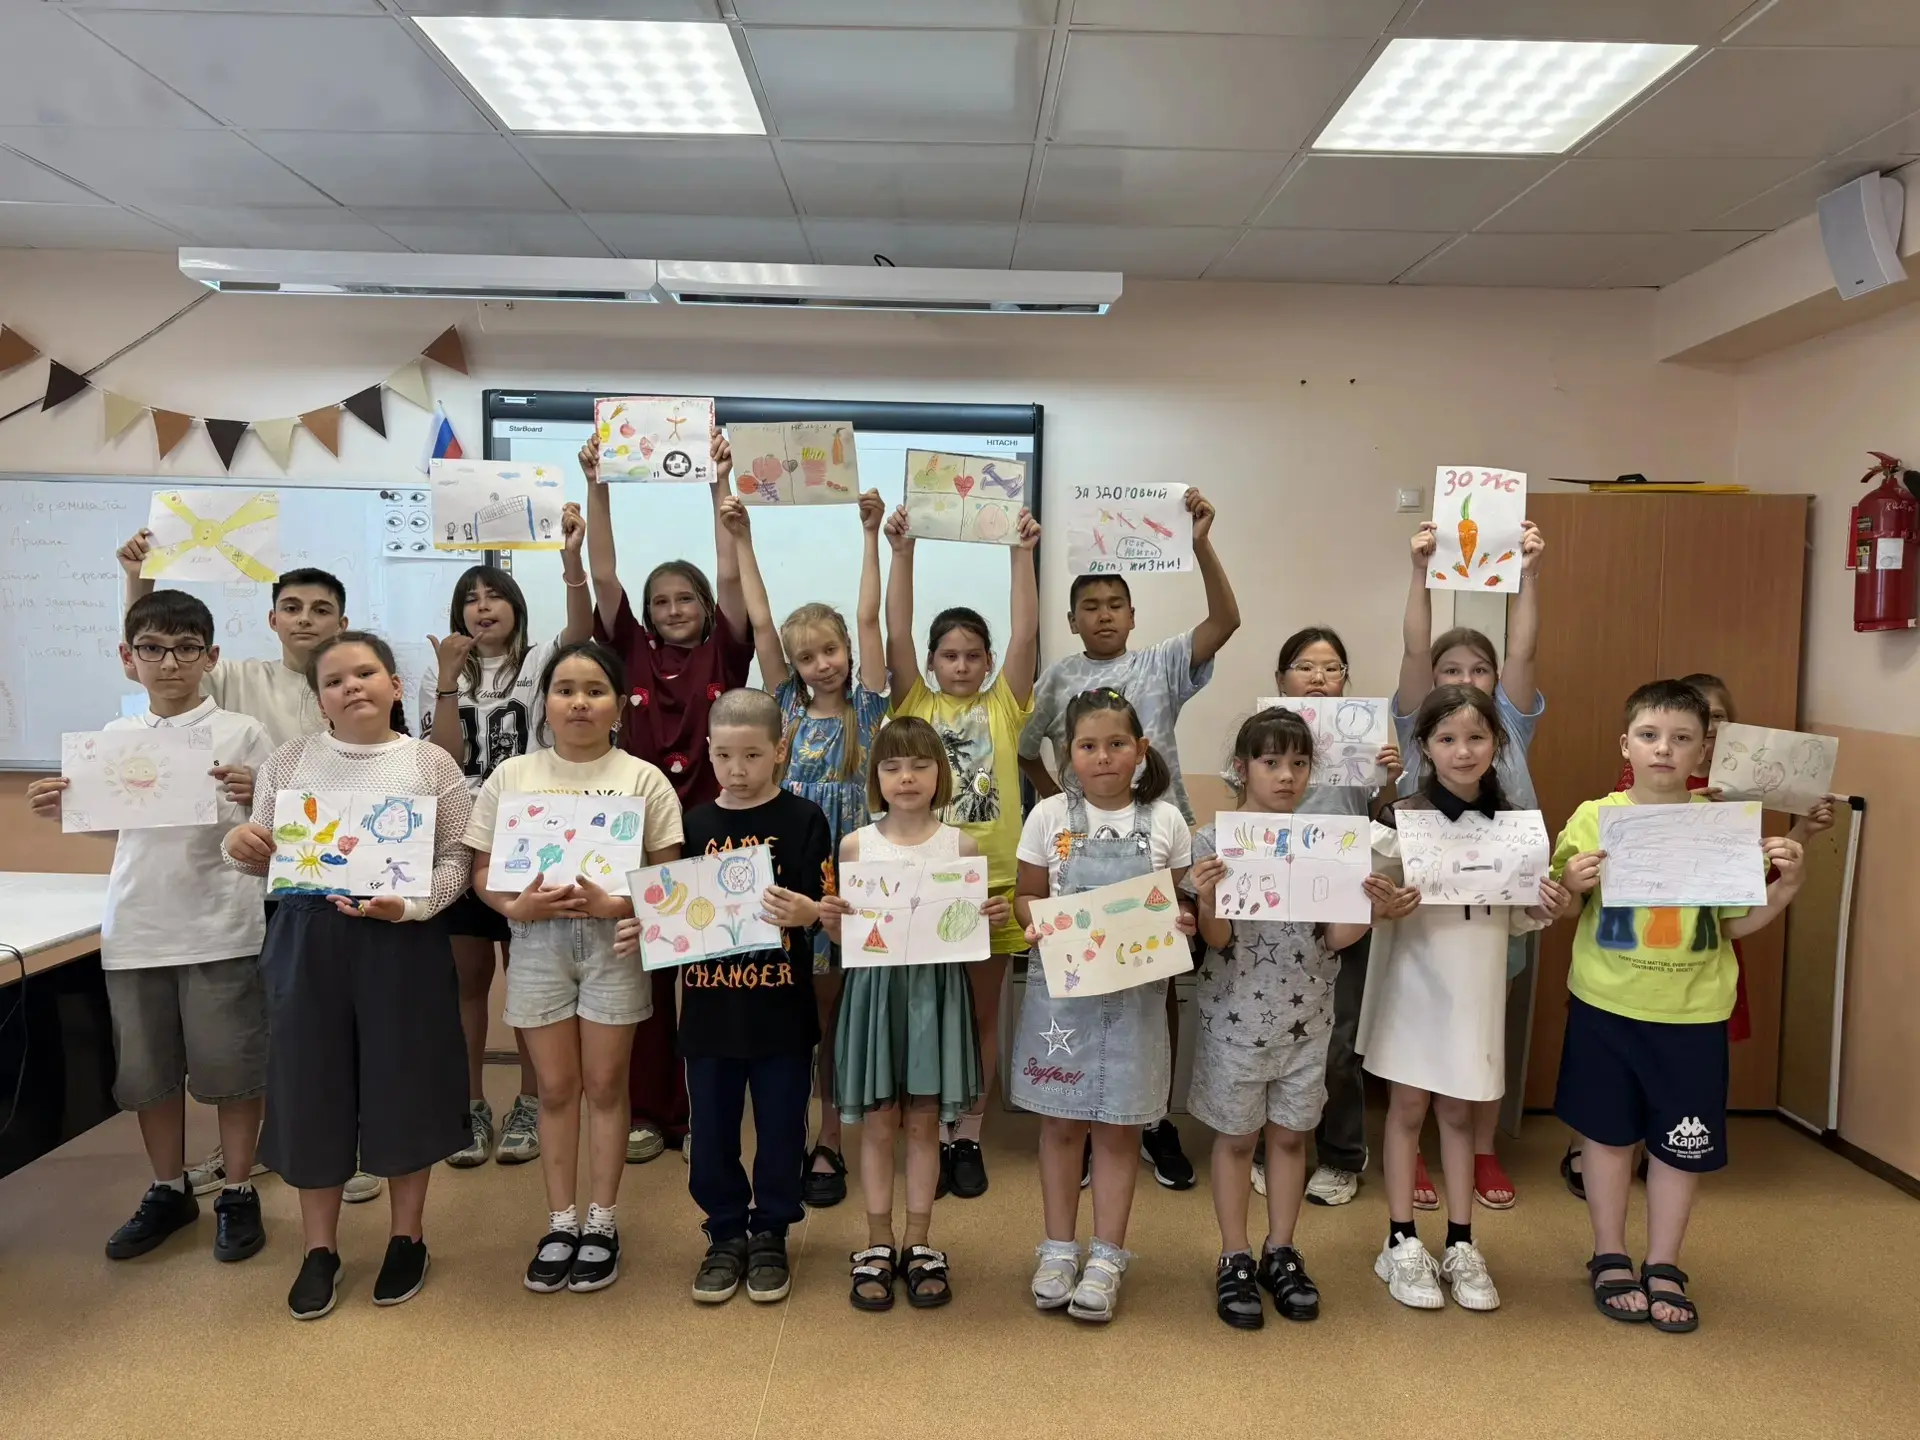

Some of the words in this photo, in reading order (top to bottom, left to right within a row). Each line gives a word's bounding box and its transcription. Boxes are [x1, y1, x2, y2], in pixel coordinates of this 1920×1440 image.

[509, 425, 543, 433] StarBoard
[1075, 486, 1089, 500] ЗА
[1096, 486, 1168, 500] ЗДОРОВЫЙ
[1129, 558, 1181, 572] ЖИЗНИ!
[685, 962, 794, 990] CHANGER
[1668, 1134, 1709, 1150] Kappa
